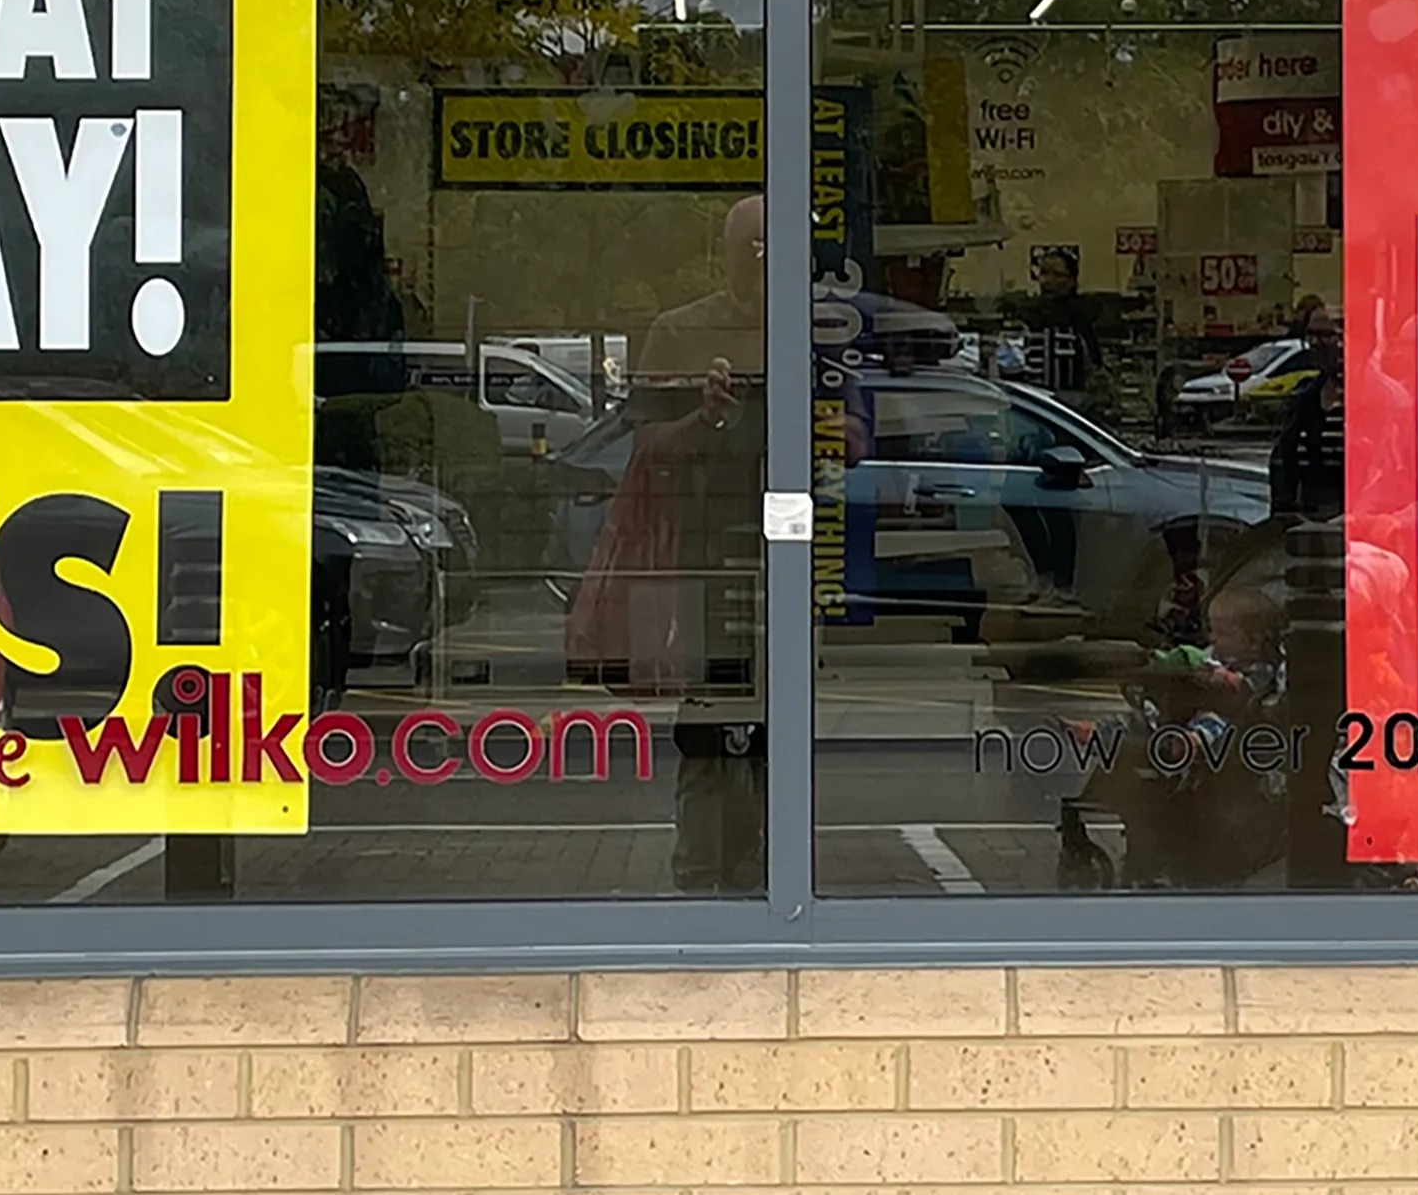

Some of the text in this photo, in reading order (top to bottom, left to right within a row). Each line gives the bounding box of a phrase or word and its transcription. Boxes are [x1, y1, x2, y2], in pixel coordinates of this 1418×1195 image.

[1258, 53, 1319, 78] here
[813, 97, 845, 141] AT
[980, 98, 1031, 121] free
[1262, 108, 1335, 139] diy &
[449, 118, 760, 161] STORE CLOSING!
[975, 127, 1034, 150] Wi-Fi
[813, 149, 845, 245] LEAST
[812, 399, 847, 618] EVERYTHING!
[57, 668, 654, 788] wilko.com
[972, 726, 1122, 774] now
[1148, 727, 1310, 774] over
